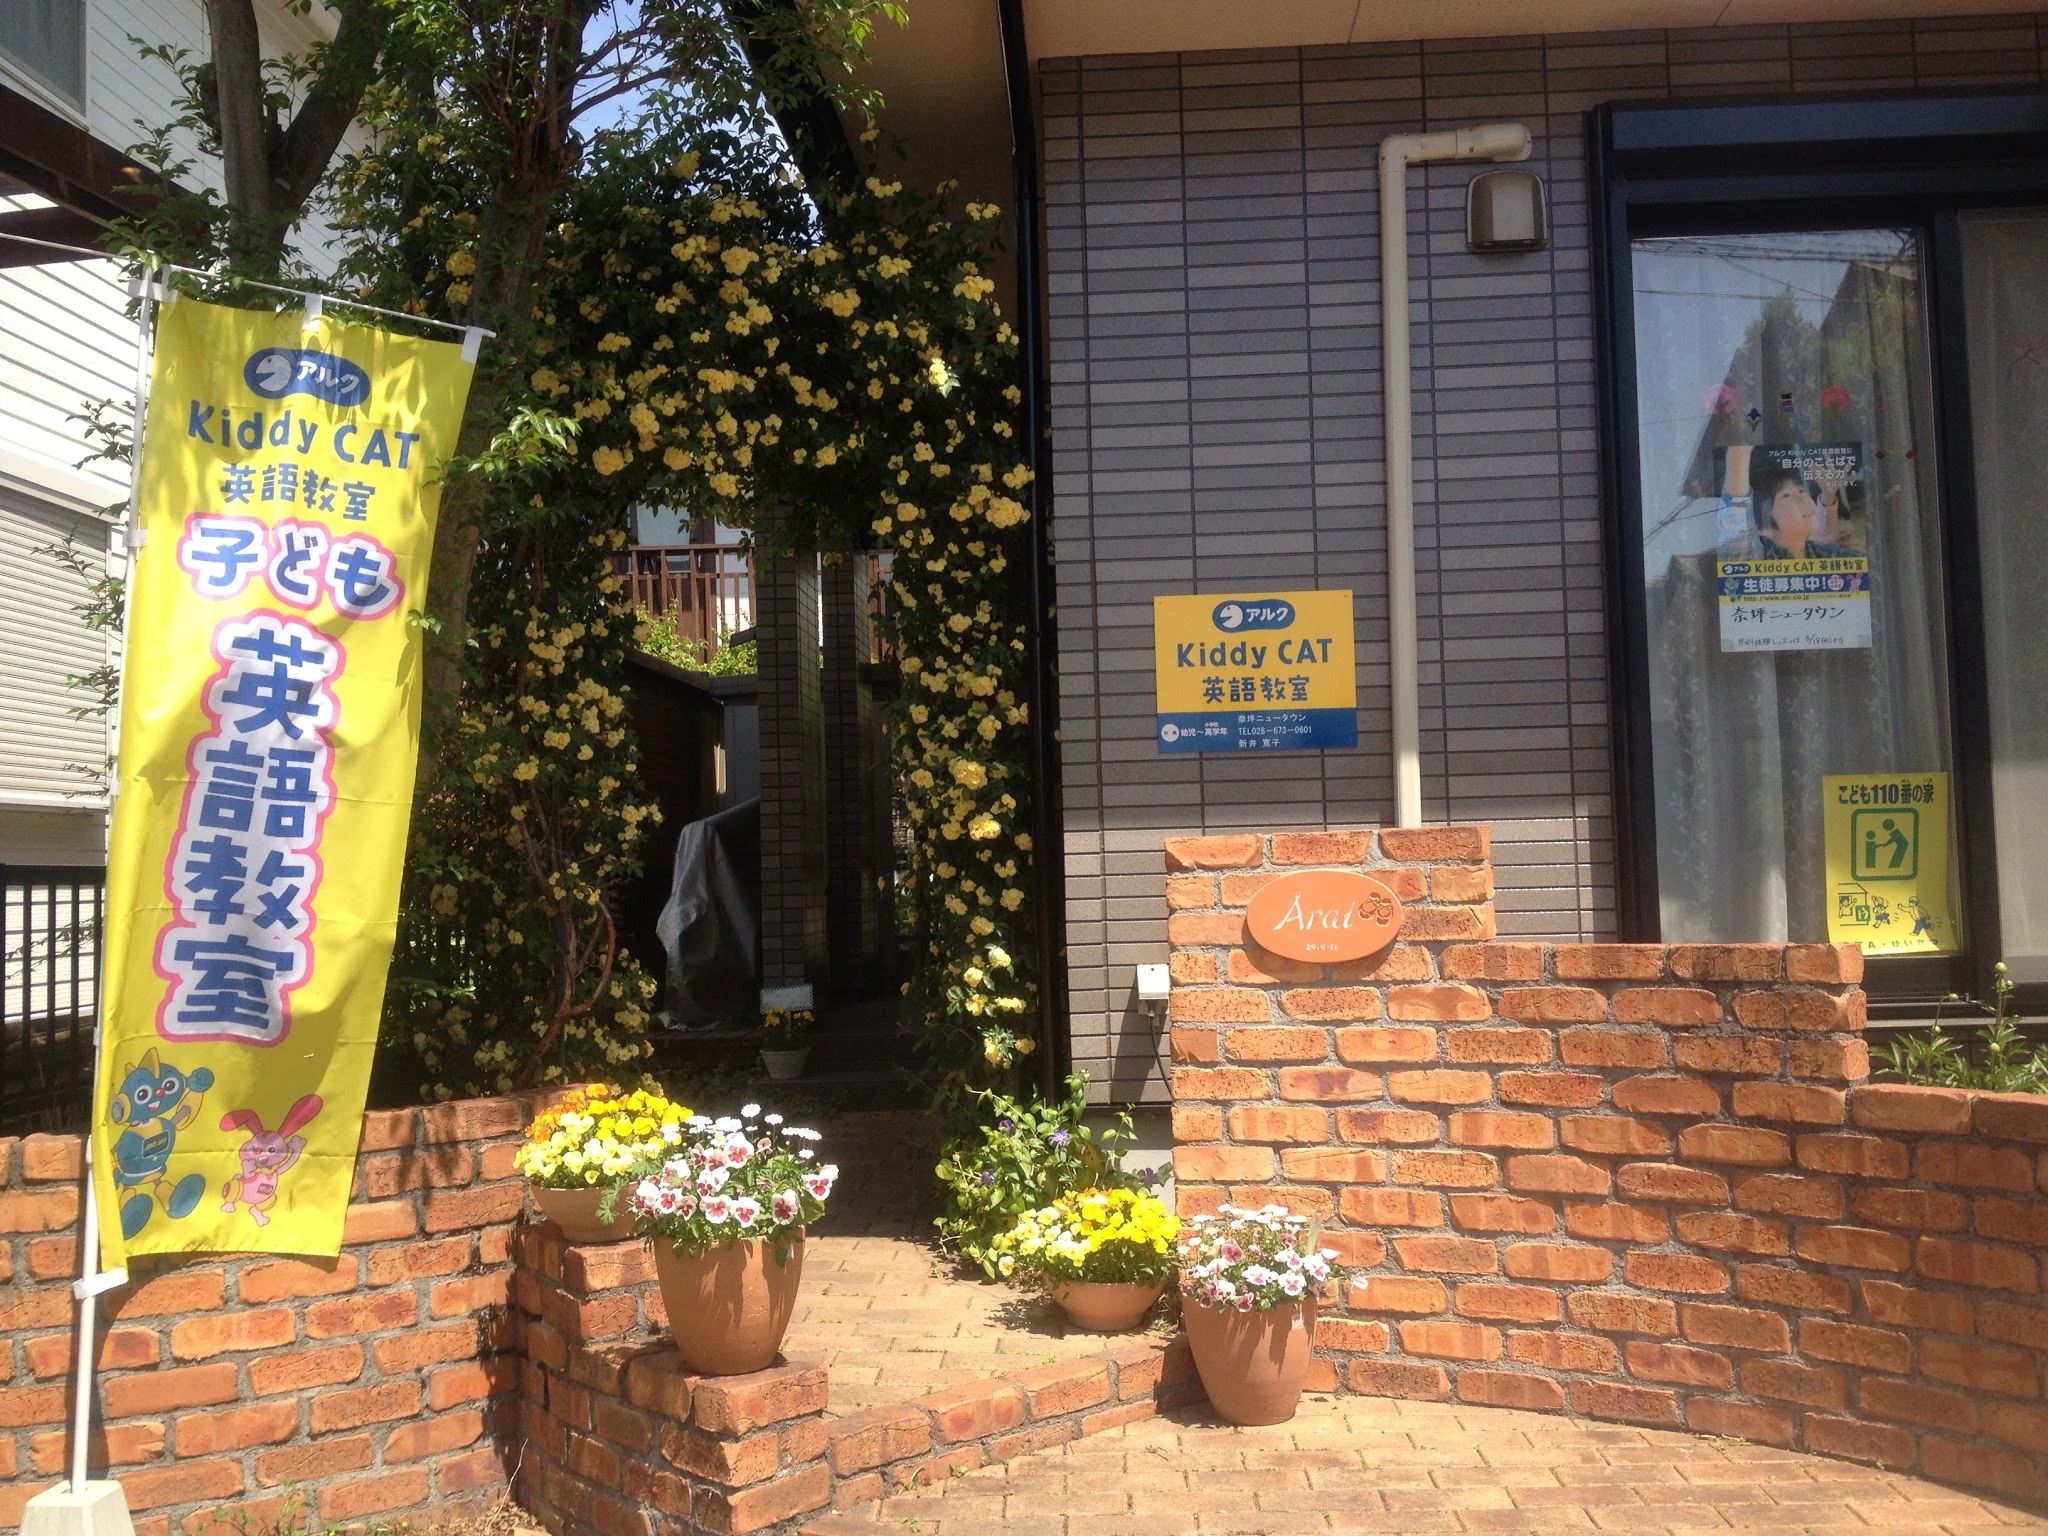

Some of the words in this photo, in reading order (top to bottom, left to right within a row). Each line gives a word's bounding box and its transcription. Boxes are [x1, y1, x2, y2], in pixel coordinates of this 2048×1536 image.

[296, 359, 361, 394] アルク
[187, 399, 318, 454] Kiddy
[334, 423, 420, 470] CAT
[220, 463, 376, 521] 英語教室
[189, 525, 395, 609] 子ども
[1731, 565, 1750, 574] アルク
[1755, 561, 1789, 574] Kiddy
[1793, 560, 1814, 572] CAT
[1819, 558, 1864, 572] 英語教室
[1246, 606, 1290, 623] アルク
[1732, 606, 1846, 624] 奈坪ニュータウン
[1177, 641, 1267, 669] Kiddy
[1278, 638, 1333, 665] CAT
[1202, 674, 1310, 704] 英語教室
[1838, 782, 1934, 804] こども110番の家
[173, 628, 325, 1030] 英語教室
[1272, 891, 1356, 931] Arai
